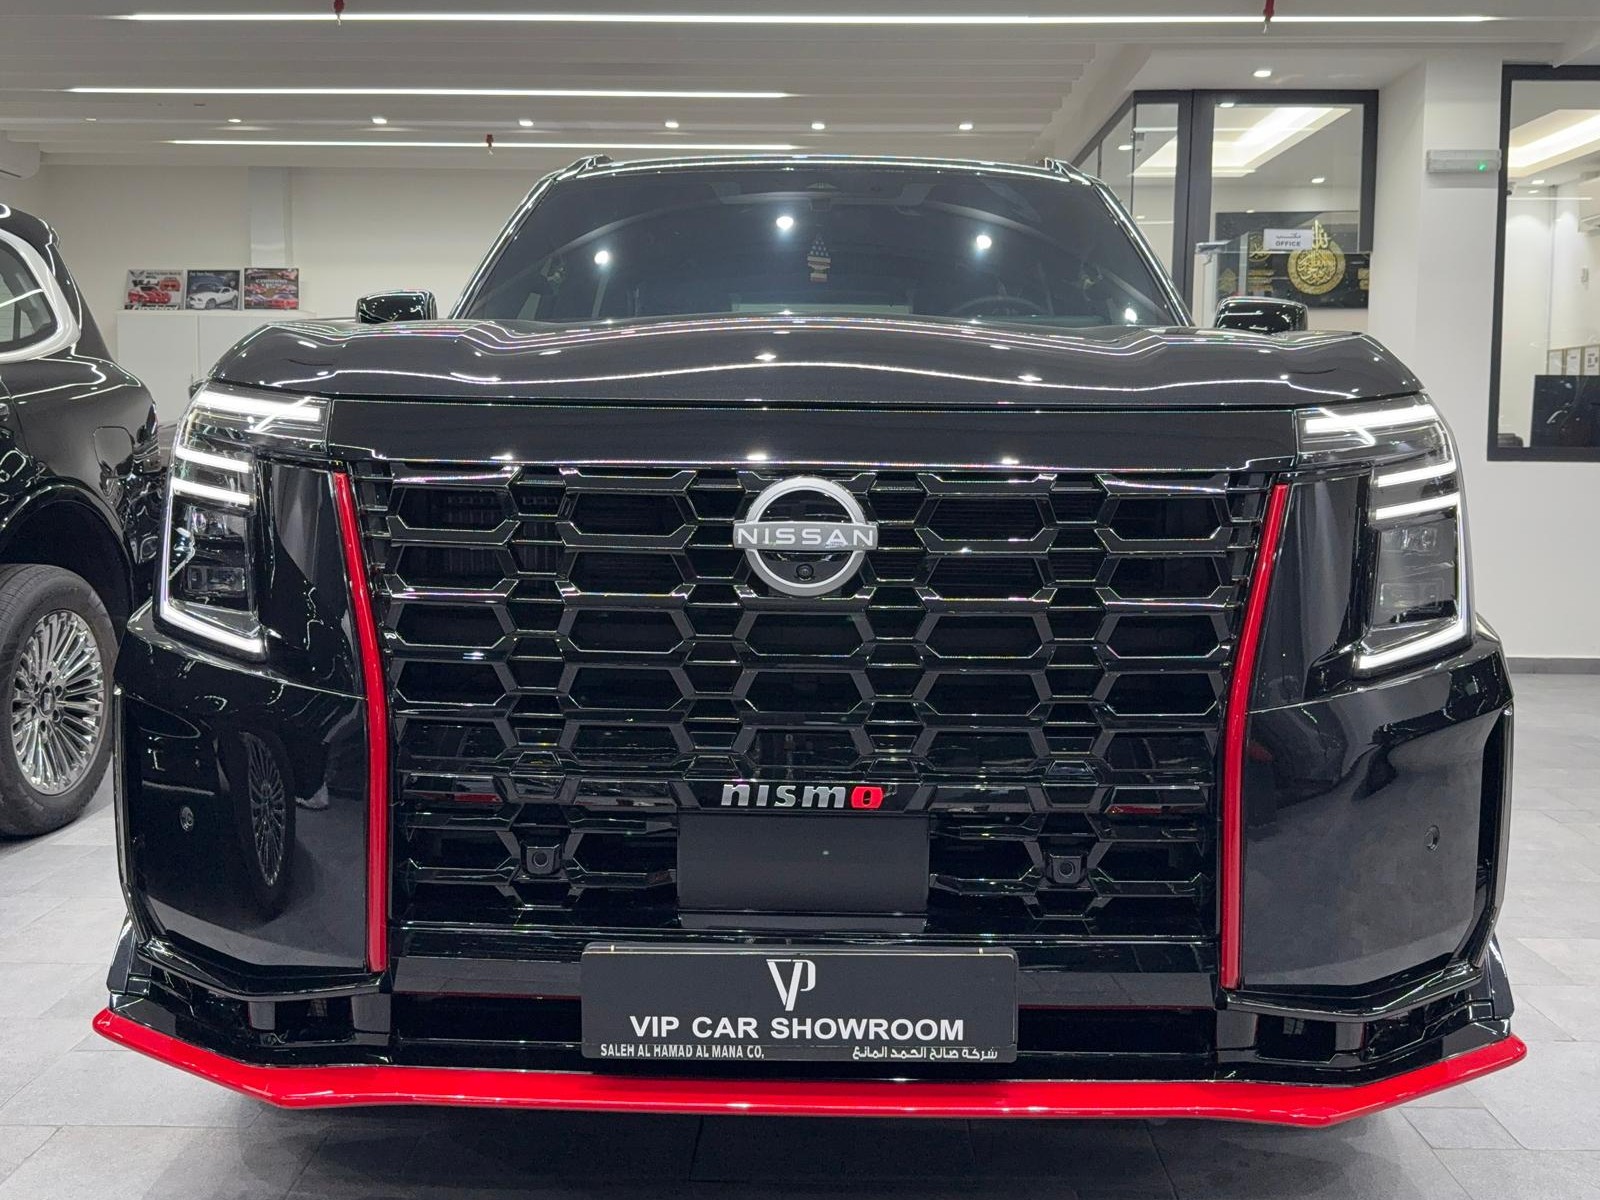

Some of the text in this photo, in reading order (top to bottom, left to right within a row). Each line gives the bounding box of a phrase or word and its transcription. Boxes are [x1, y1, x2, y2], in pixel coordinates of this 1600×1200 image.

[737, 527, 873, 546] NISSAN
[629, 1015, 964, 1041] VIP CAR SHOWROOM
[600, 1043, 635, 1057] SALEH
[637, 1044, 650, 1057] AL
[653, 1044, 693, 1058] HAMAD
[695, 1045, 709, 1058] AL
[712, 1045, 744, 1058] MANA
[852, 1046, 998, 1061] شركة صالح الحمد المانع
